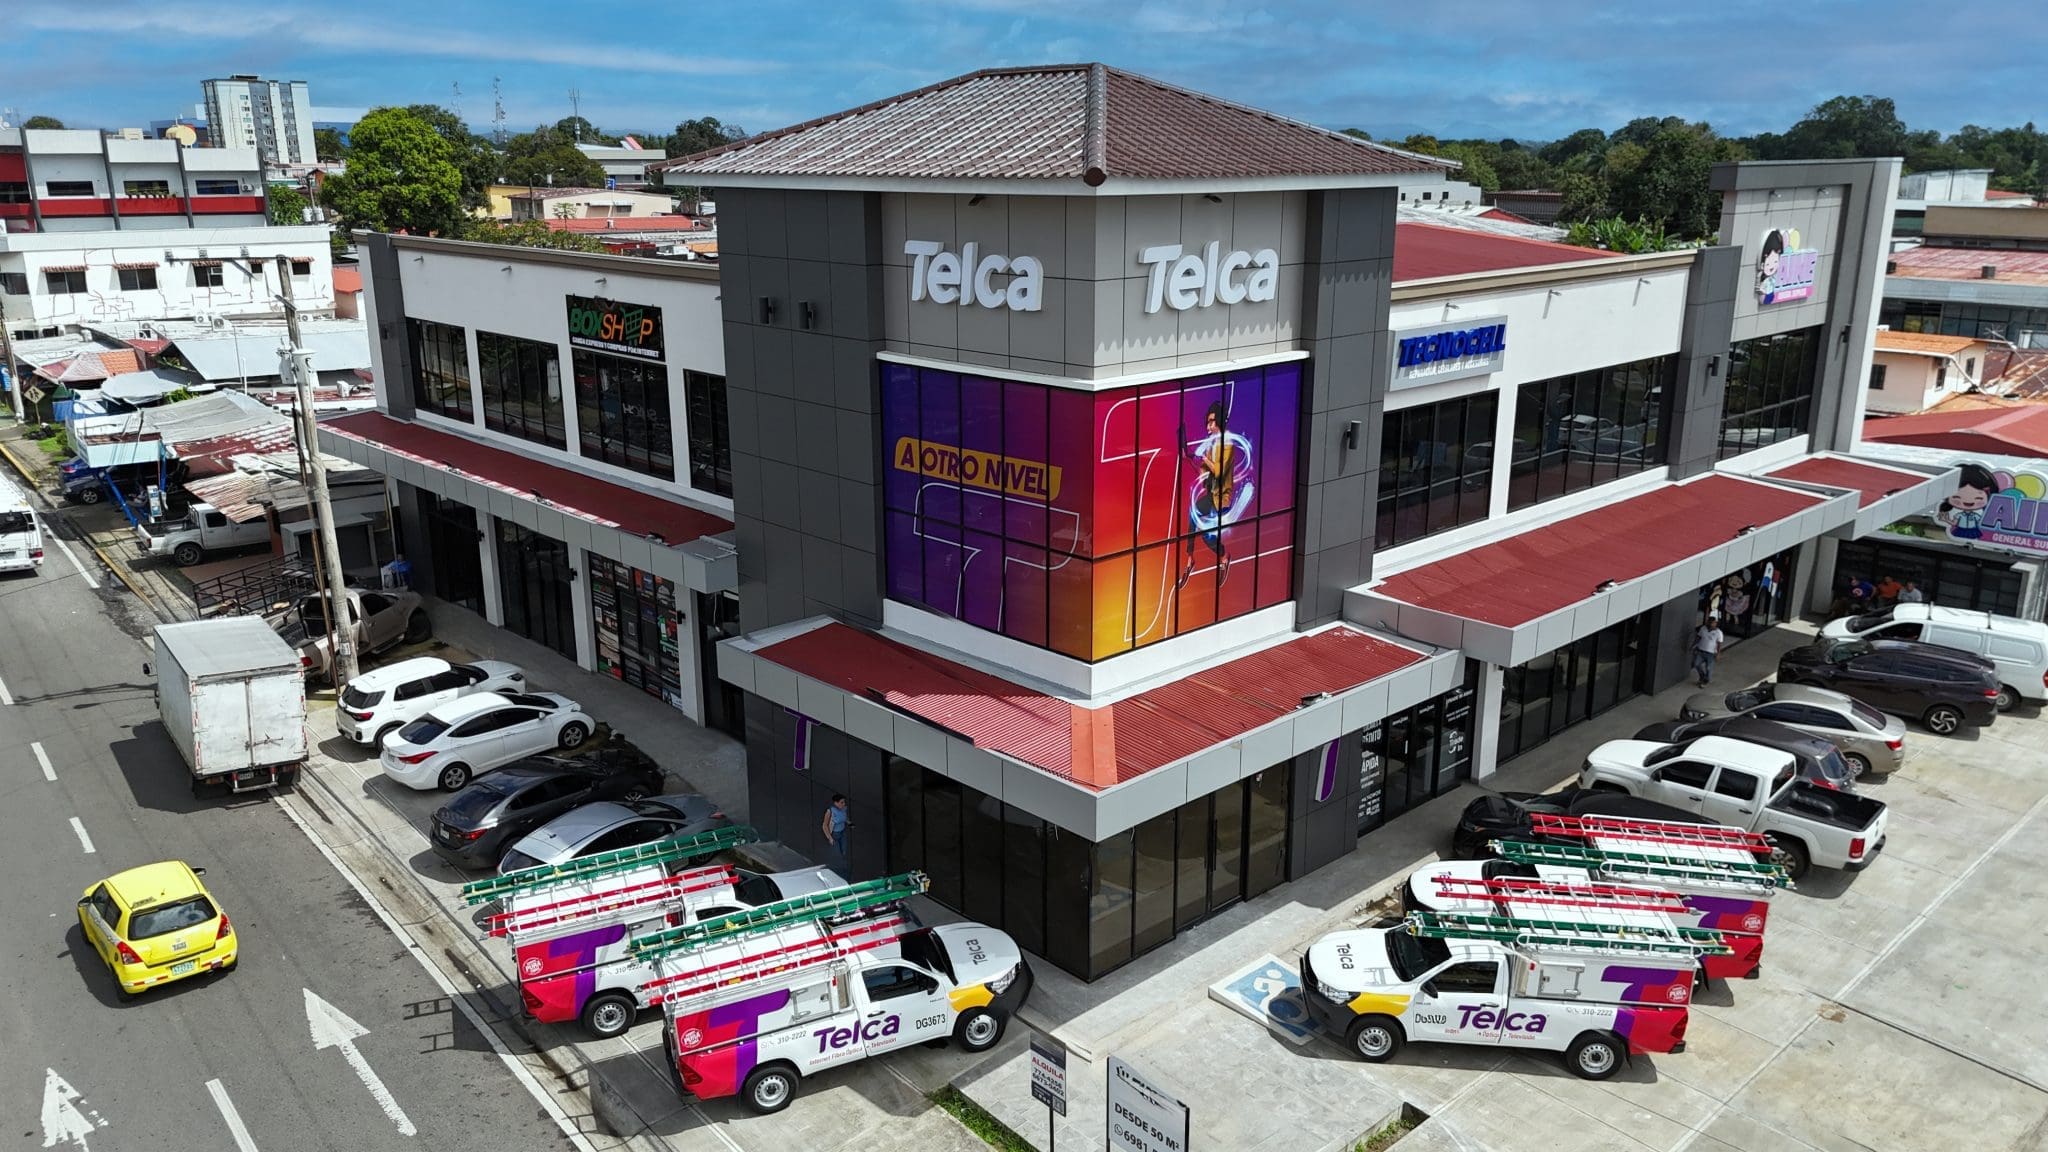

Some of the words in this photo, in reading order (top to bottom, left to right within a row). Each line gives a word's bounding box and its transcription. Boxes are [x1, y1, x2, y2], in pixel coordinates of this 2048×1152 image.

[904, 240, 1043, 311] Telca
[1138, 240, 1279, 313] Telca
[1398, 324, 1505, 367] TECNOCELL
[901, 443, 915, 468] A
[921, 447, 979, 481] OTRO
[984, 459, 1048, 496] NIVEL
[1992, 533, 2032, 547] GENERAL
[2034, 539, 2048, 550] SU
[966, 939, 988, 966] Telca
[1336, 943, 1354, 969] Telca
[915, 1013, 946, 1030] DG3673
[1457, 1005, 1547, 1033] Telca
[1582, 1008, 1613, 1017] 310-2222
[777, 1031, 807, 1044] 310-2222
[813, 1014, 901, 1053] Telca
[809, 1056, 831, 1065] Internet
[831, 1052, 846, 1060] Fibra
[1031, 1056, 1064, 1080] ALQUILA
[1114, 1102, 1149, 1133] DESDE
[1150, 1127, 1164, 1142] 50
[1124, 1130, 1147, 1152] 6981
